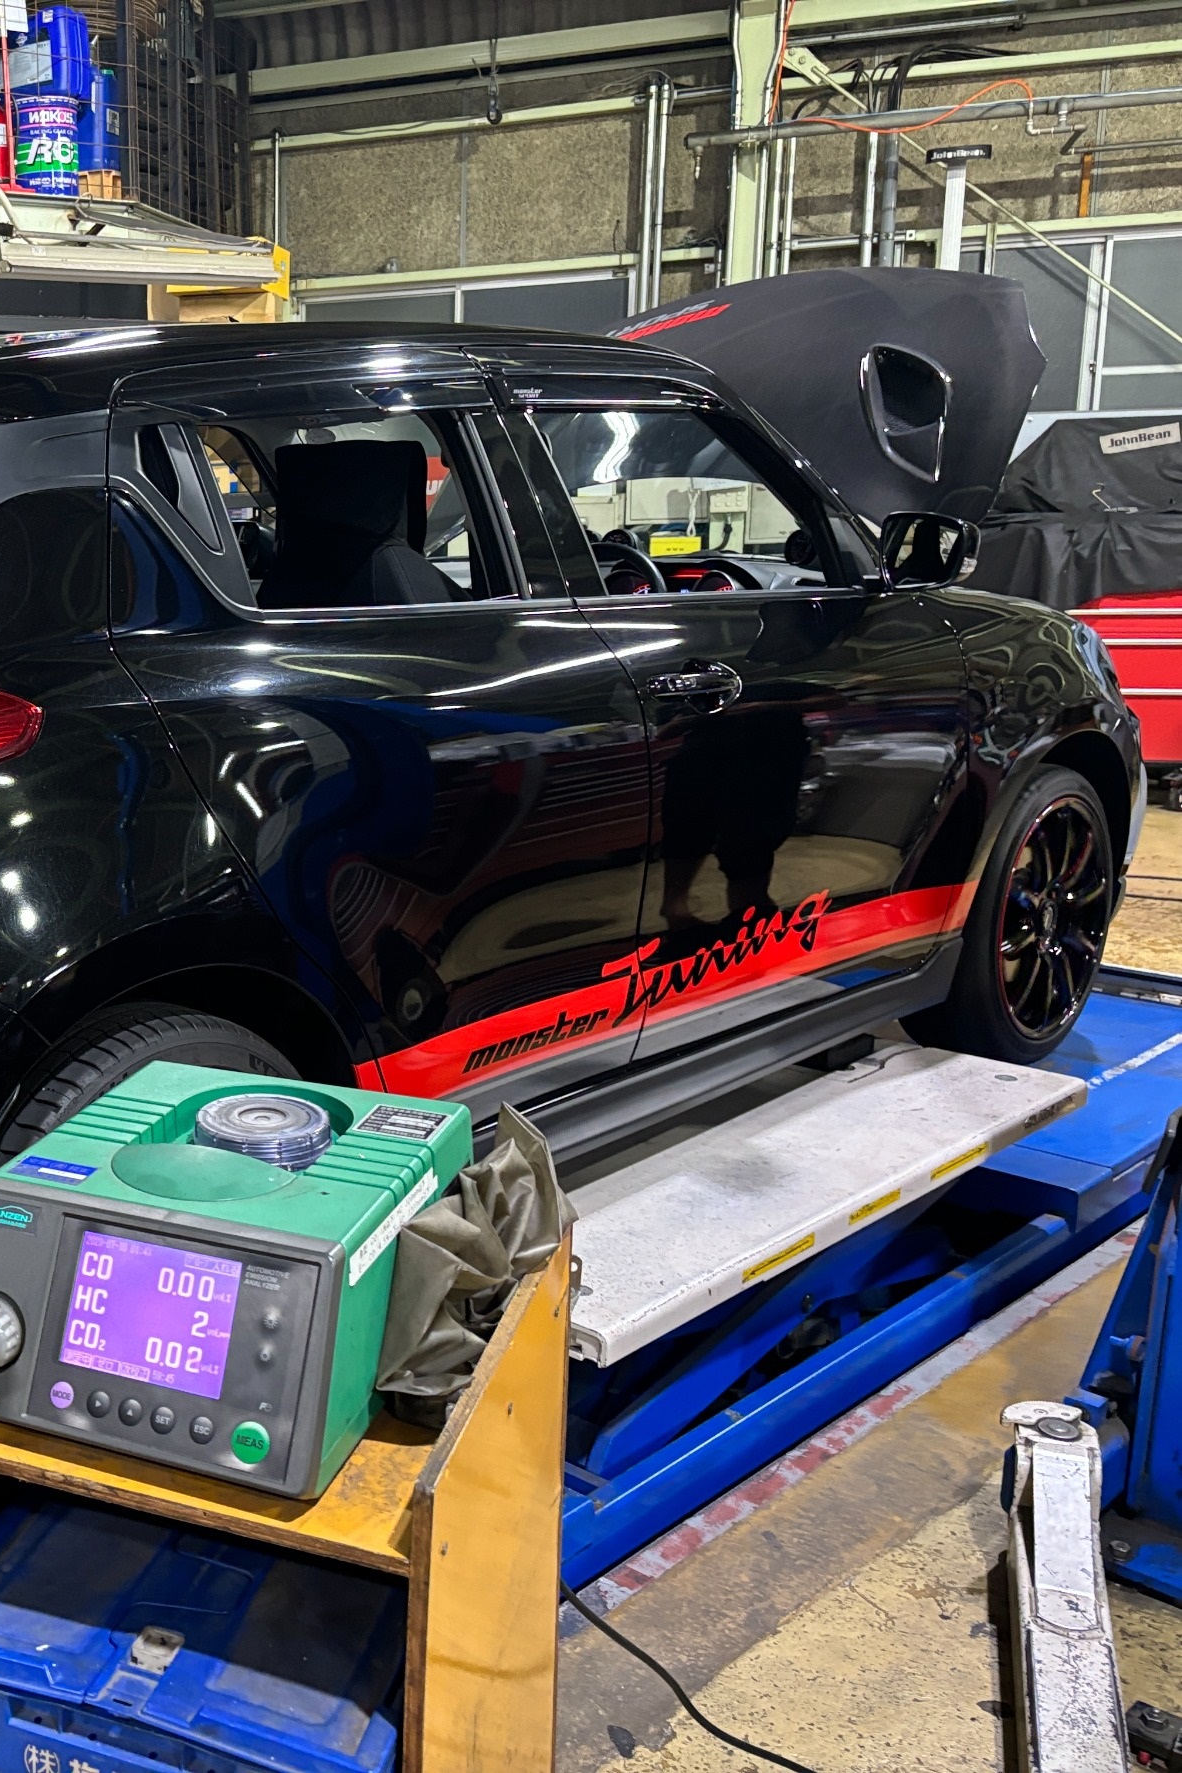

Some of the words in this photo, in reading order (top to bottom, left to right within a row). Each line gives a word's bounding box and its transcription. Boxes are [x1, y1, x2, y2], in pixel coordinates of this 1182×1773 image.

[1108, 431, 1171, 448] JohnBean
[462, 1007, 610, 1074] monster
[601, 888, 833, 1029] Tuning
[81, 1251, 114, 1281] CO
[157, 1267, 216, 1303] 0.00
[74, 1284, 109, 1315] HC
[190, 1310, 209, 1338] 2
[144, 1336, 203, 1374] 0.02
[52, 1389, 72, 1400] MODE
[154, 1414, 171, 1426] SET
[193, 1424, 211, 1436] ESC
[235, 1434, 264, 1450] MEAS
